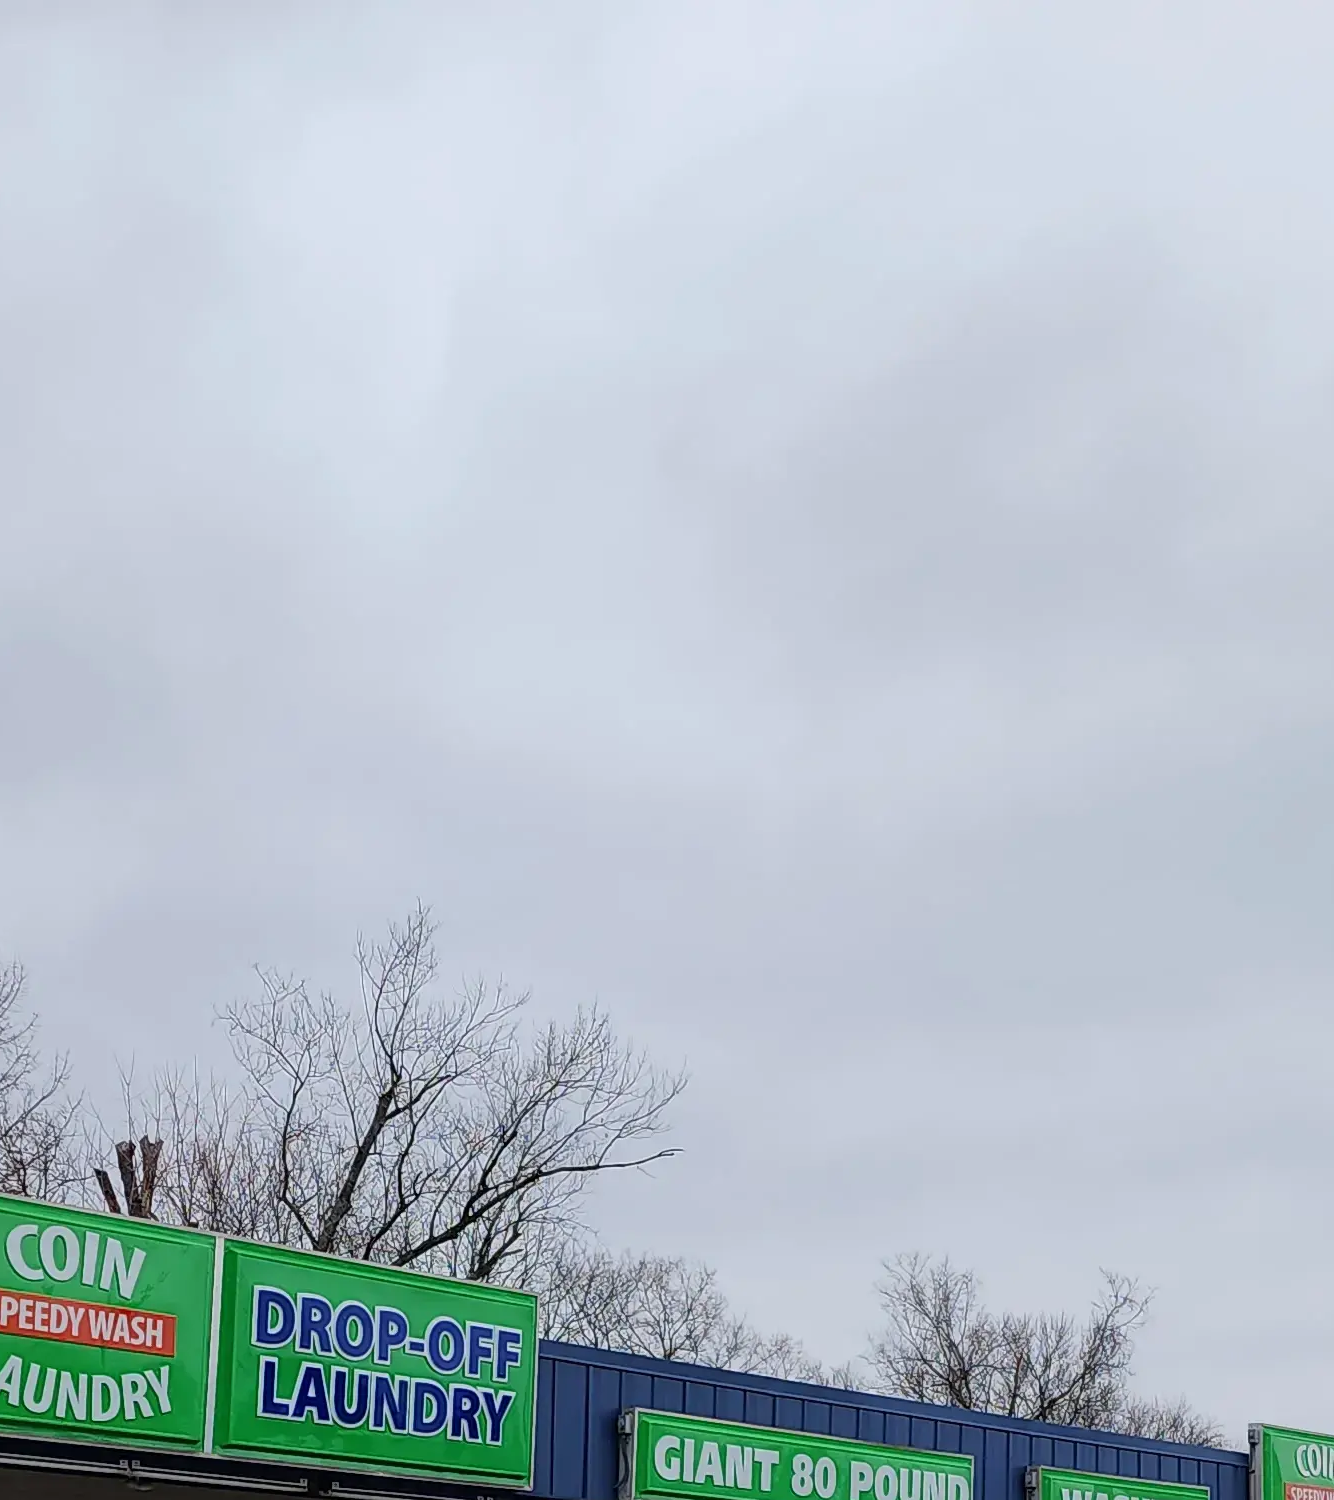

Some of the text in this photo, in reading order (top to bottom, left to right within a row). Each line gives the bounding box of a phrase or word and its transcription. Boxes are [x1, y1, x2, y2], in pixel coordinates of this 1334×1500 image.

[4, 1223, 147, 1300] COIN
[89, 1308, 164, 1349] WASH
[251, 1284, 522, 1384] DROP-OFF
[255, 1356, 518, 1448] LAUNDRY
[654, 1435, 780, 1492] GIANT
[790, 1453, 838, 1500] 80
